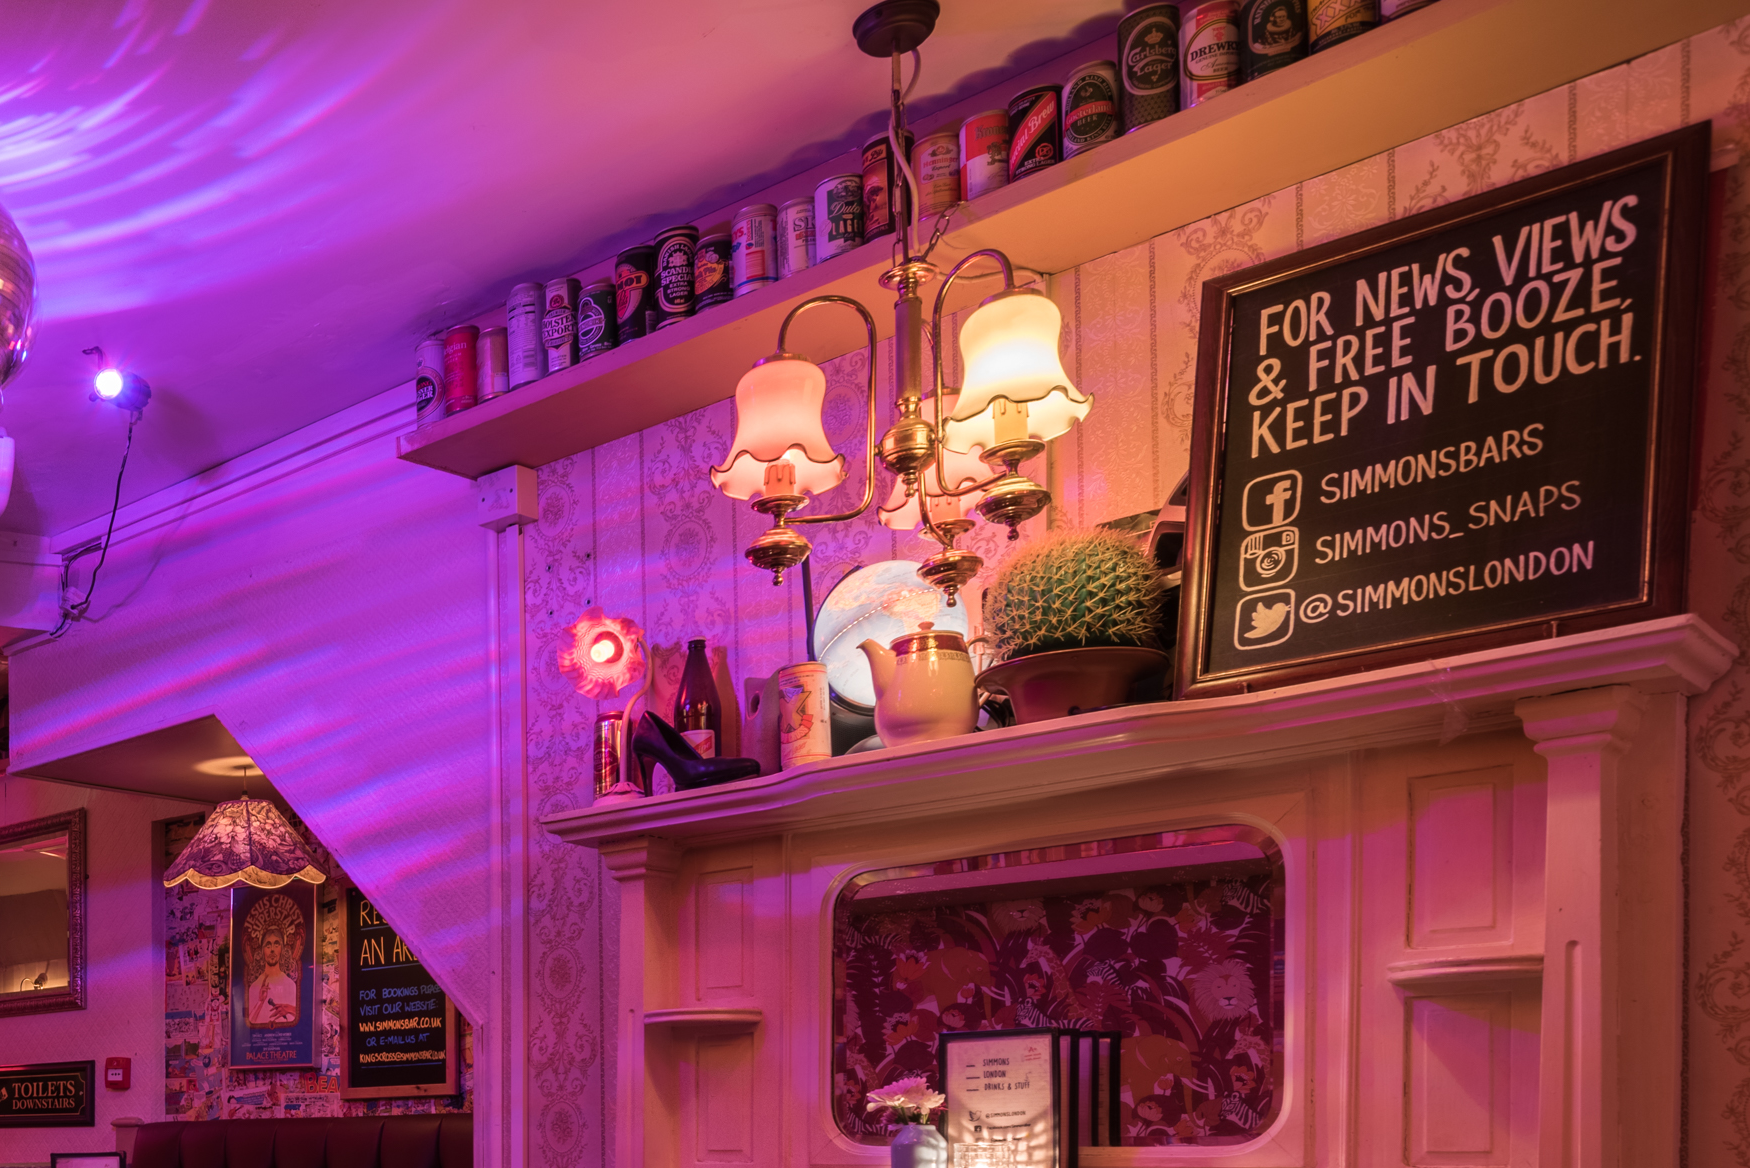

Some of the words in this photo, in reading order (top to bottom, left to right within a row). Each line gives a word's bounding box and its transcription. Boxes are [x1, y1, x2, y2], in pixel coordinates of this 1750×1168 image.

[1128, 45, 1177, 66] Carlsberg
[1190, 40, 1241, 62] DREWRY
[1133, 61, 1173, 76] Lager
[1028, 100, 1055, 134] Brew
[661, 274, 694, 287] SPECIA
[1259, 291, 1334, 356] FOR
[1492, 195, 1639, 287] VIEWS
[667, 286, 690, 294] STRONG
[1248, 359, 1287, 406] &
[1307, 317, 1416, 392] FREE
[1251, 386, 1369, 459] KEEP
[1386, 366, 1437, 424] IN
[1456, 312, 1642, 404] TOUCH.
[1320, 423, 1545, 504] SIMMONSBARS
[1315, 481, 1582, 564] SIMMONS_SNAPS
[1299, 541, 1594, 624] @SIMMONSLONDON
[244, 896, 270, 931] JESUS
[271, 894, 305, 925] CHRIST
[251, 907, 297, 938] SUPERSTAR
[360, 936, 384, 966] AN
[360, 989, 376, 1001] FOR
[383, 986, 418, 999] BOOKINGS
[360, 1004, 380, 1016] VISIT
[383, 1002, 402, 1014] OUR
[366, 1036, 377, 1047] OR
[406, 1033, 415, 1043] US
[418, 1033, 430, 1042] AT
[246, 1051, 269, 1060] PALACE
[270, 1050, 297, 1059] THEATRE
[983, 1058, 1010, 1066] SIMMONS
[983, 1070, 1006, 1078] LONDON
[12, 1080, 75, 1098] TOILETS
[1014, 1081, 1030, 1090] STUFF
[12, 1098, 75, 1109] DOWNSTAIRS
